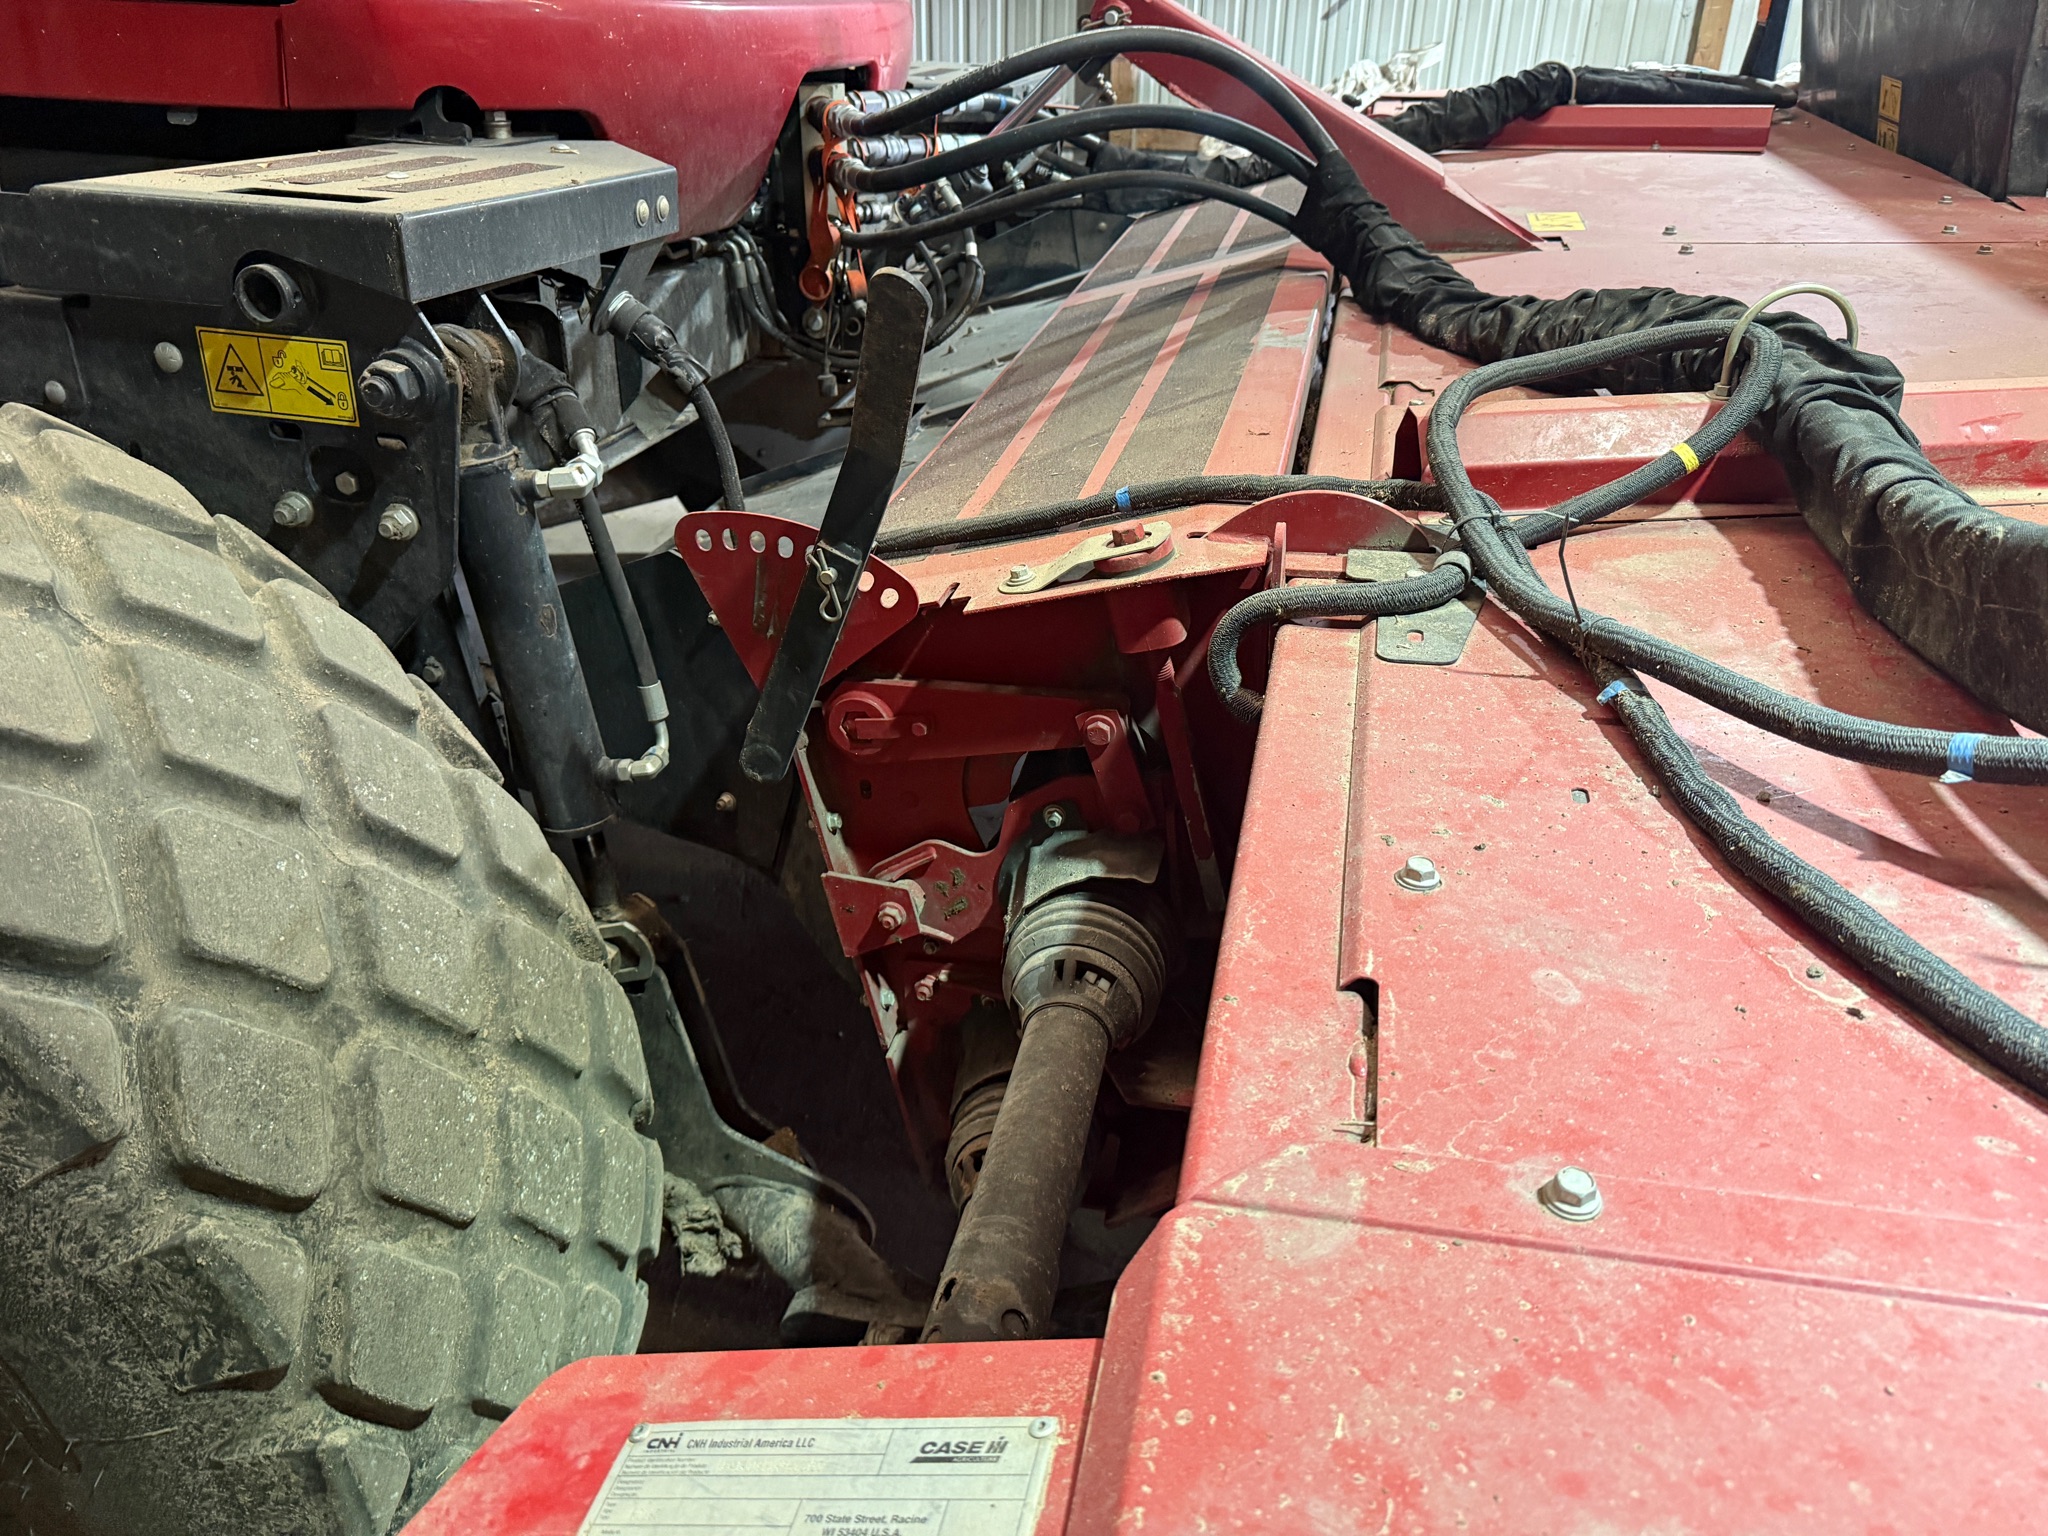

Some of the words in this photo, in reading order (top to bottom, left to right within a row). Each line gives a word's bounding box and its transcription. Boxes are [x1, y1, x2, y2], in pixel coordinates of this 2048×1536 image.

[686, 1439, 707, 1449] CNH
[708, 1438, 753, 1449] Industrial
[753, 1438, 794, 1448] America
[795, 1437, 815, 1448] LLC
[920, 1441, 986, 1454] CASE
[804, 1514, 823, 1524] 700
[825, 1514, 852, 1524] State
[890, 1514, 928, 1524] Racine
[822, 1527, 836, 1536] WI
[837, 1527, 869, 1536] 53404
